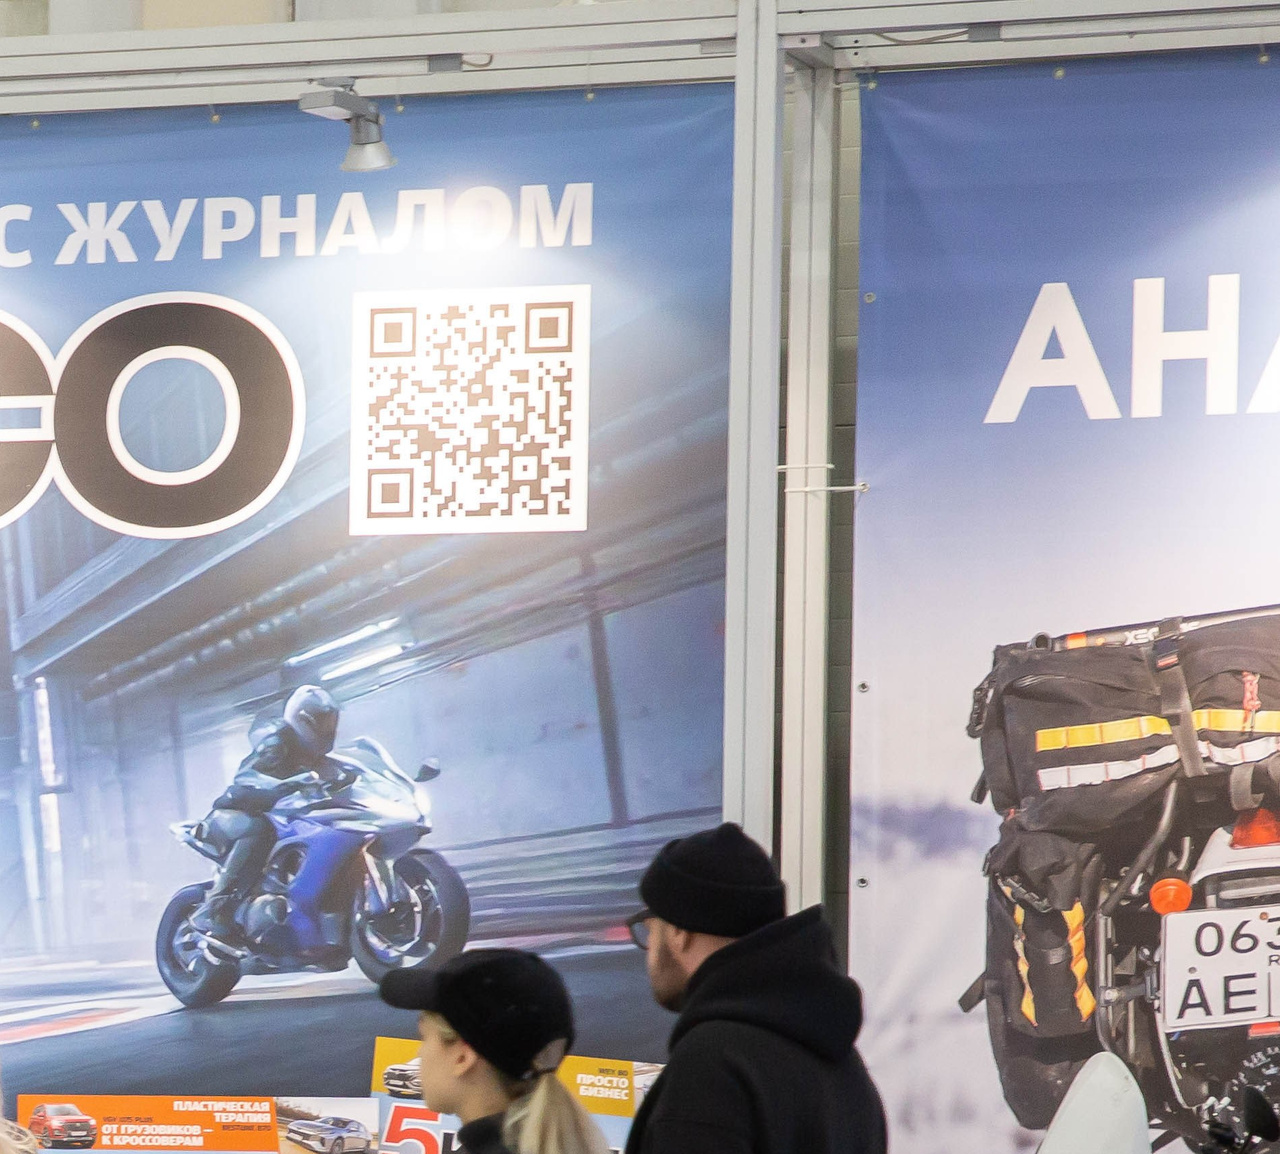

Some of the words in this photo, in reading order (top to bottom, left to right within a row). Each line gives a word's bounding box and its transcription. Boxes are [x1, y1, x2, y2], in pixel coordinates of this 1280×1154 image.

[54, 182, 593, 265] ЖУРНАЛОМ
[983, 273, 1280, 424] АН
[576, 1073, 629, 1088] ПРОСТО
[579, 1085, 629, 1100] БИЗНЕС
[173, 1101, 270, 1112] ПЛАСТИЧЕСКАЯ
[214, 1112, 271, 1123] ТЕРАПИЯ
[101, 1124, 118, 1134] ОТ
[120, 1125, 201, 1135] ГРУЗОВИКОВ
[101, 1136, 111, 1145] К
[113, 1136, 204, 1146] КРОССОВЕРАМ
